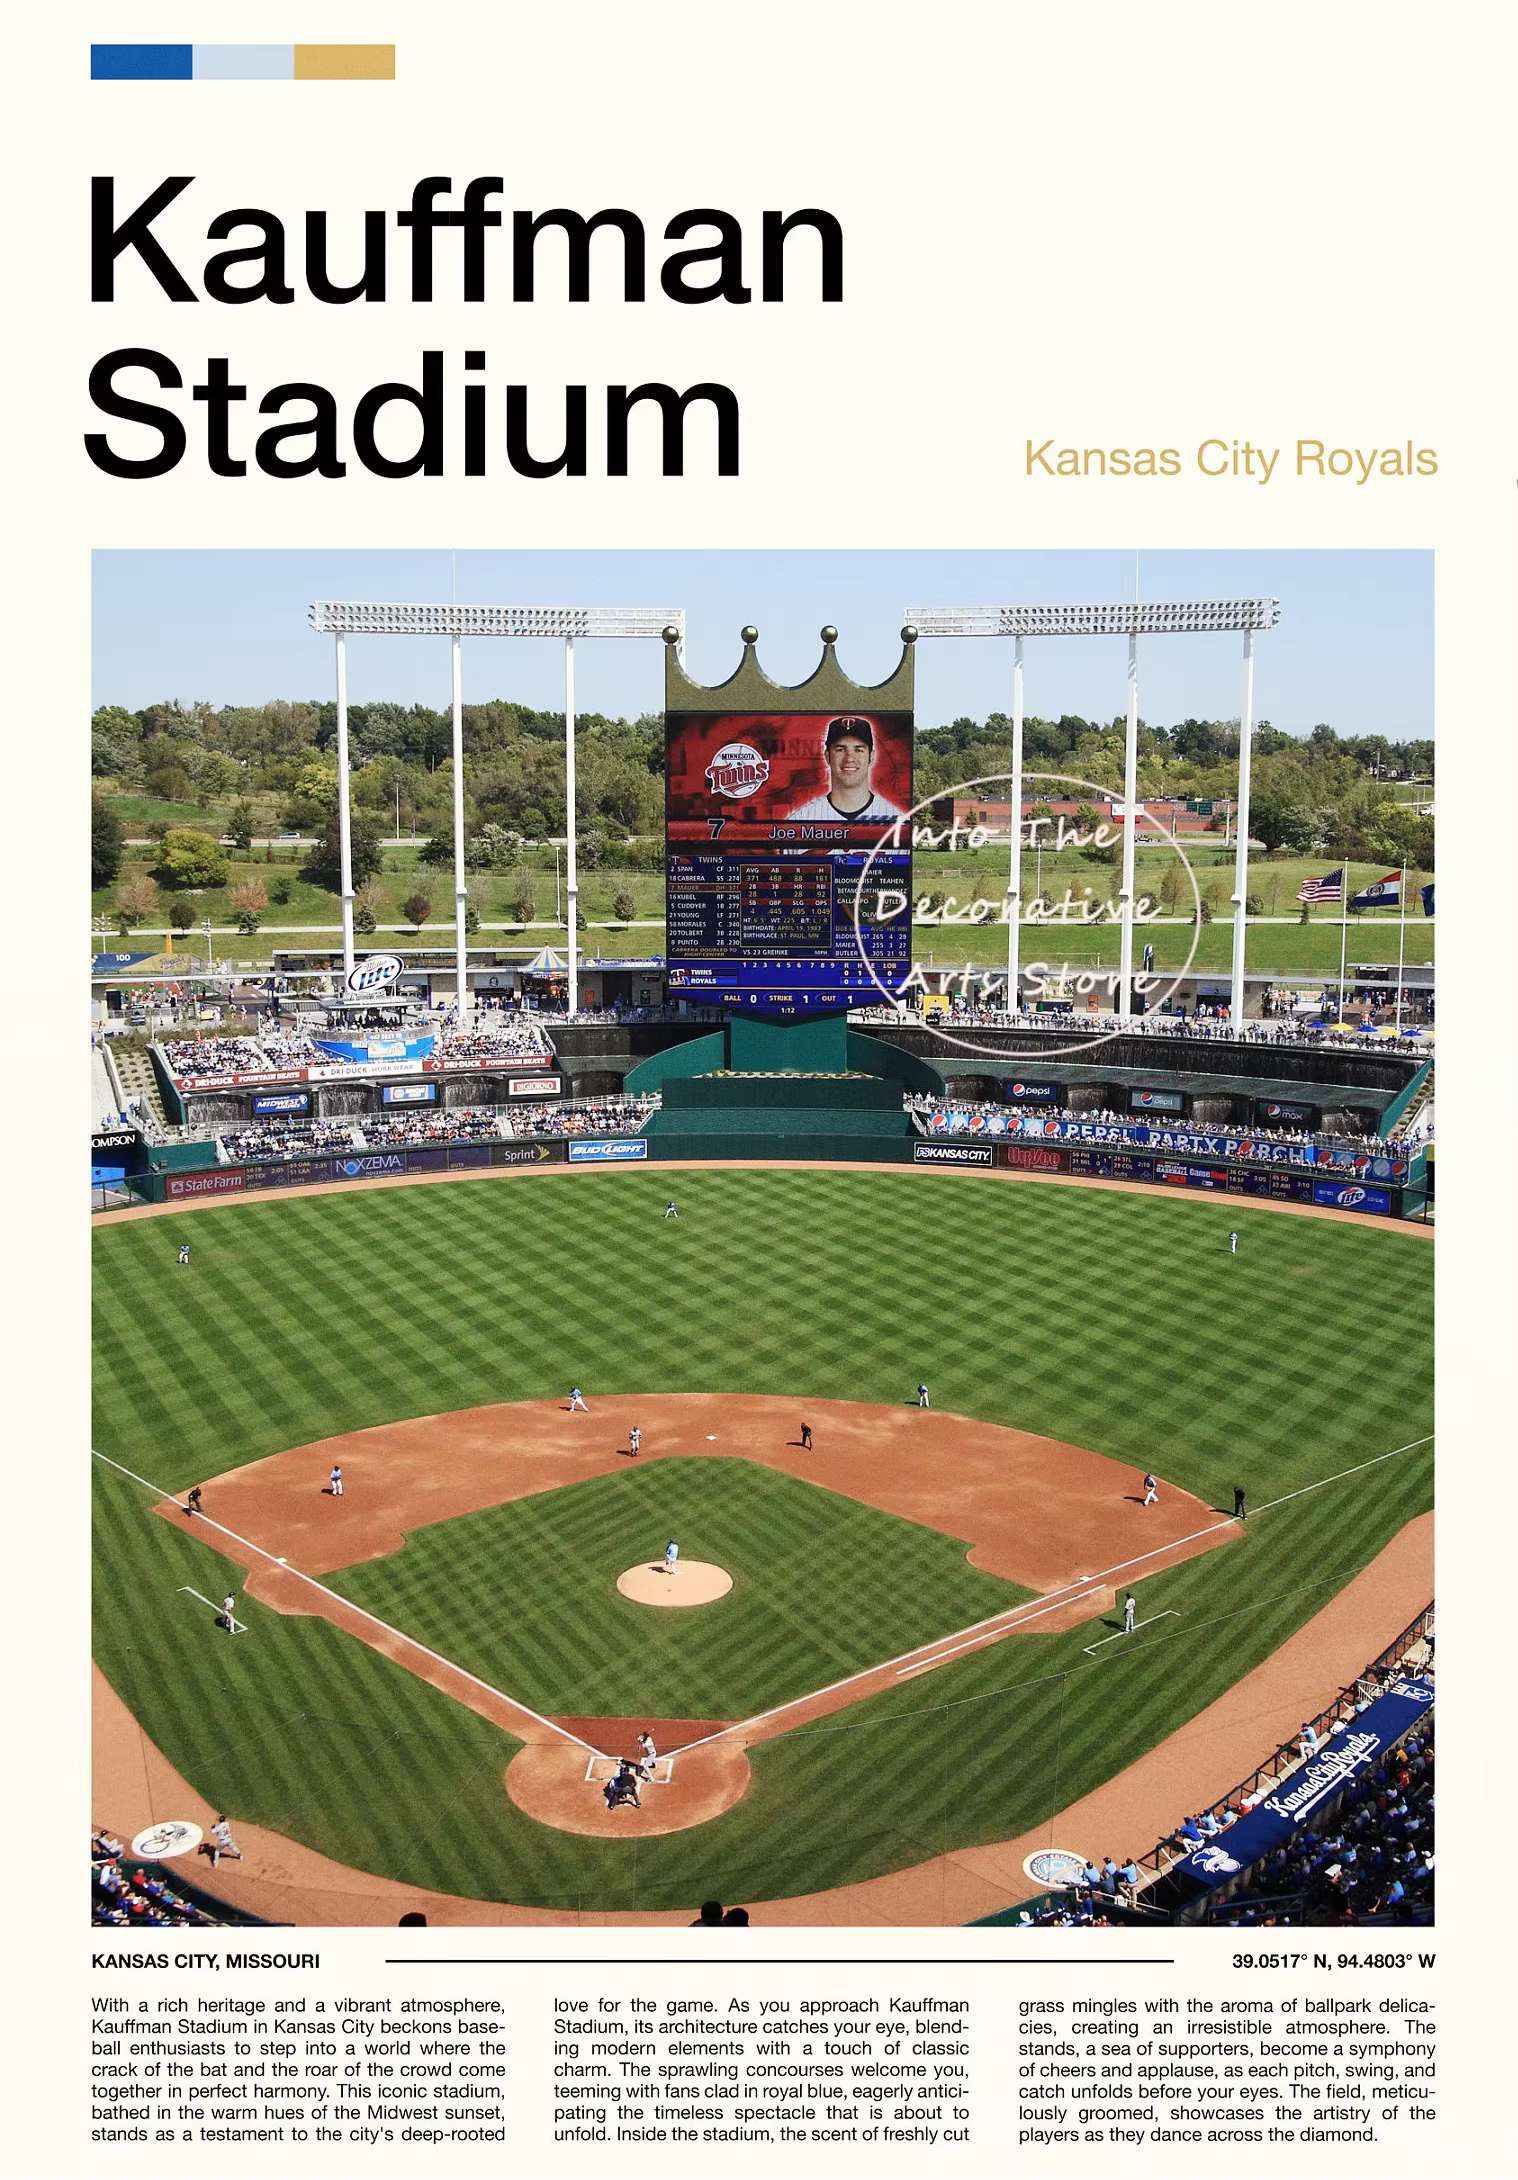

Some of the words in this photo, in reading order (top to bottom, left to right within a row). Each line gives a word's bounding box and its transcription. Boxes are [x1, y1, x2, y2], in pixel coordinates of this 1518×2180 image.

[91, 176, 843, 304] Kauffman
[84, 348, 739, 479] Stadium
[1026, 440, 1181, 475] Kansas
[1198, 440, 1279, 484] City
[1297, 440, 1438, 484] Royals
[706, 762, 768, 791] Twins
[706, 818, 725, 840] 7
[768, 826, 795, 840] Joe
[801, 826, 849, 840] Mauer
[698, 856, 723, 864] TWINS
[115, 954, 131, 962] 100
[359, 965, 395, 991] Lite
[750, 995, 757, 1003] 0
[485, 1058, 523, 1066] FOUNTAIN
[238, 1074, 276, 1083] FOUNTAIN
[277, 1071, 300, 1080] SEATS
[1026, 1087, 1050, 1095] pepsi
[257, 1098, 302, 1108] MIDWEST
[1154, 1098, 1172, 1106] pepsi
[1281, 1111, 1303, 1120] max
[1067, 1124, 1130, 1142] PEPSI
[1149, 1131, 1219, 1150] PARTY
[505, 1149, 535, 1162] Sprint
[572, 1146, 601, 1155] BUD
[604, 1143, 645, 1155] LIGHT
[929, 1148, 968, 1159] KANSAS
[968, 1151, 990, 1161] CITY
[336, 1155, 401, 1174] NOXZEMA
[185, 1178, 213, 1192] State
[214, 1175, 242, 1188] Farm
[92, 1954, 169, 1968] KANSAS
[174, 1954, 220, 1971] CITY,
[226, 1954, 319, 1968] MISSOURI
[1233, 1954, 1307, 1968] 39.0517°
[1314, 1954, 1331, 1971] N,
[1338, 1954, 1412, 1968] 94.4803°
[1418, 1954, 1436, 1968] W
[92, 1998, 128, 2012] With
[139, 2001, 148, 2012] a
[158, 1998, 188, 2012] rich
[198, 1998, 265, 2016] heritage
[275, 1998, 305, 2012] and
[316, 2001, 325, 2012] a
[334, 1998, 391, 2012] vibrant
[401, 1998, 504, 2016] atmosphere,
[555, 1998, 588, 2012] love
[598, 1998, 621, 2012] for
[630, 1998, 656, 2012] the
[667, 2001, 717, 2016] game.
[728, 1998, 749, 2012] As
[759, 2001, 789, 2016] you
[800, 1998, 879, 2016] approach
[890, 1998, 969, 2012] Kauffman
[1019, 2002, 1064, 2016] grass
[1073, 1998, 1137, 2016] mingles
[1145, 1998, 1178, 2012] with
[1187, 1998, 1213, 2012] the
[1221, 2002, 1273, 2012] aroma
[1281, 1998, 1297, 2012] of
[1306, 1998, 1371, 2016] ballpark
[1379, 1998, 1435, 2012] delica-
[93, 2019, 171, 2034] Kauffman
[178, 2019, 247, 2034] Stadium
[254, 2019, 267, 2033] in
[275, 2019, 335, 2033] Kansas
[342, 2019, 374, 2037] City
[381, 2019, 451, 2033] beckons
[459, 2019, 505, 2033] base-
[1020, 2127, 1079, 2145] players
[1085, 2131, 1104, 2141] as
[1109, 2127, 1145, 2145] they
[1151, 2127, 1202, 2141] dance
[1208, 2131, 1262, 2141] across
[1268, 2127, 1294, 2141] the
[1300, 2127, 1377, 2141] diamond.
